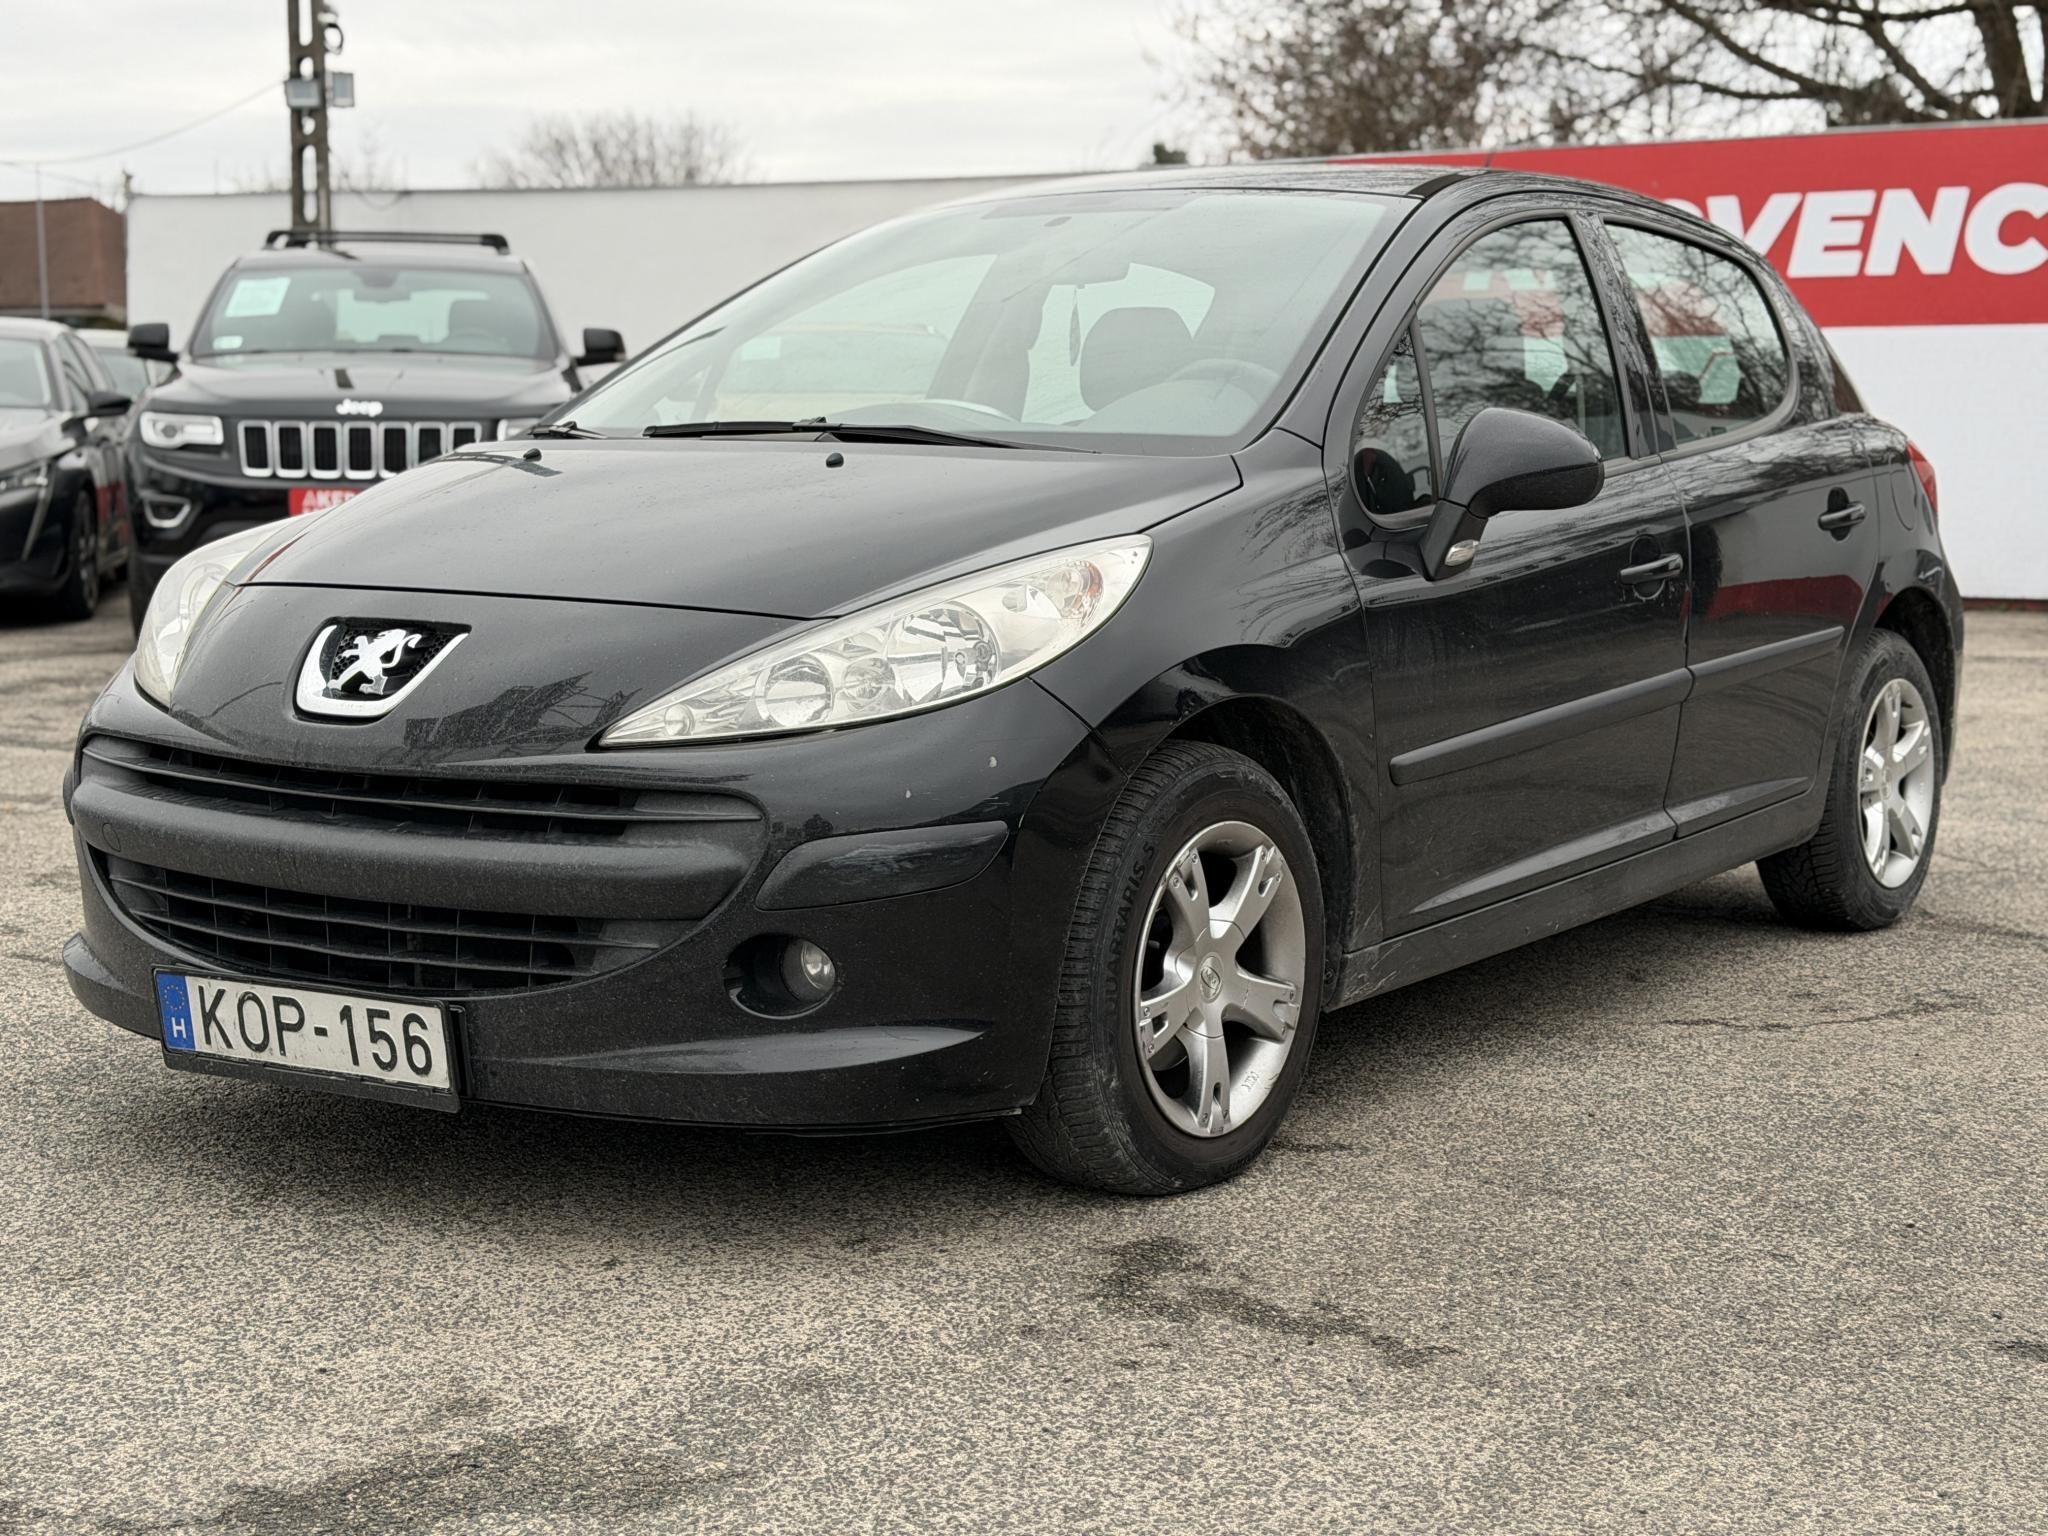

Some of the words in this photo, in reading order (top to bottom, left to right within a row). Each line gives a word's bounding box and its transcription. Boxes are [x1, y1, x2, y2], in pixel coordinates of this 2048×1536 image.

[1663, 182, 2048, 278] VENC
[336, 398, 383, 418] Jeep
[171, 1016, 187, 1039] H
[197, 985, 433, 1077] KOP-156
